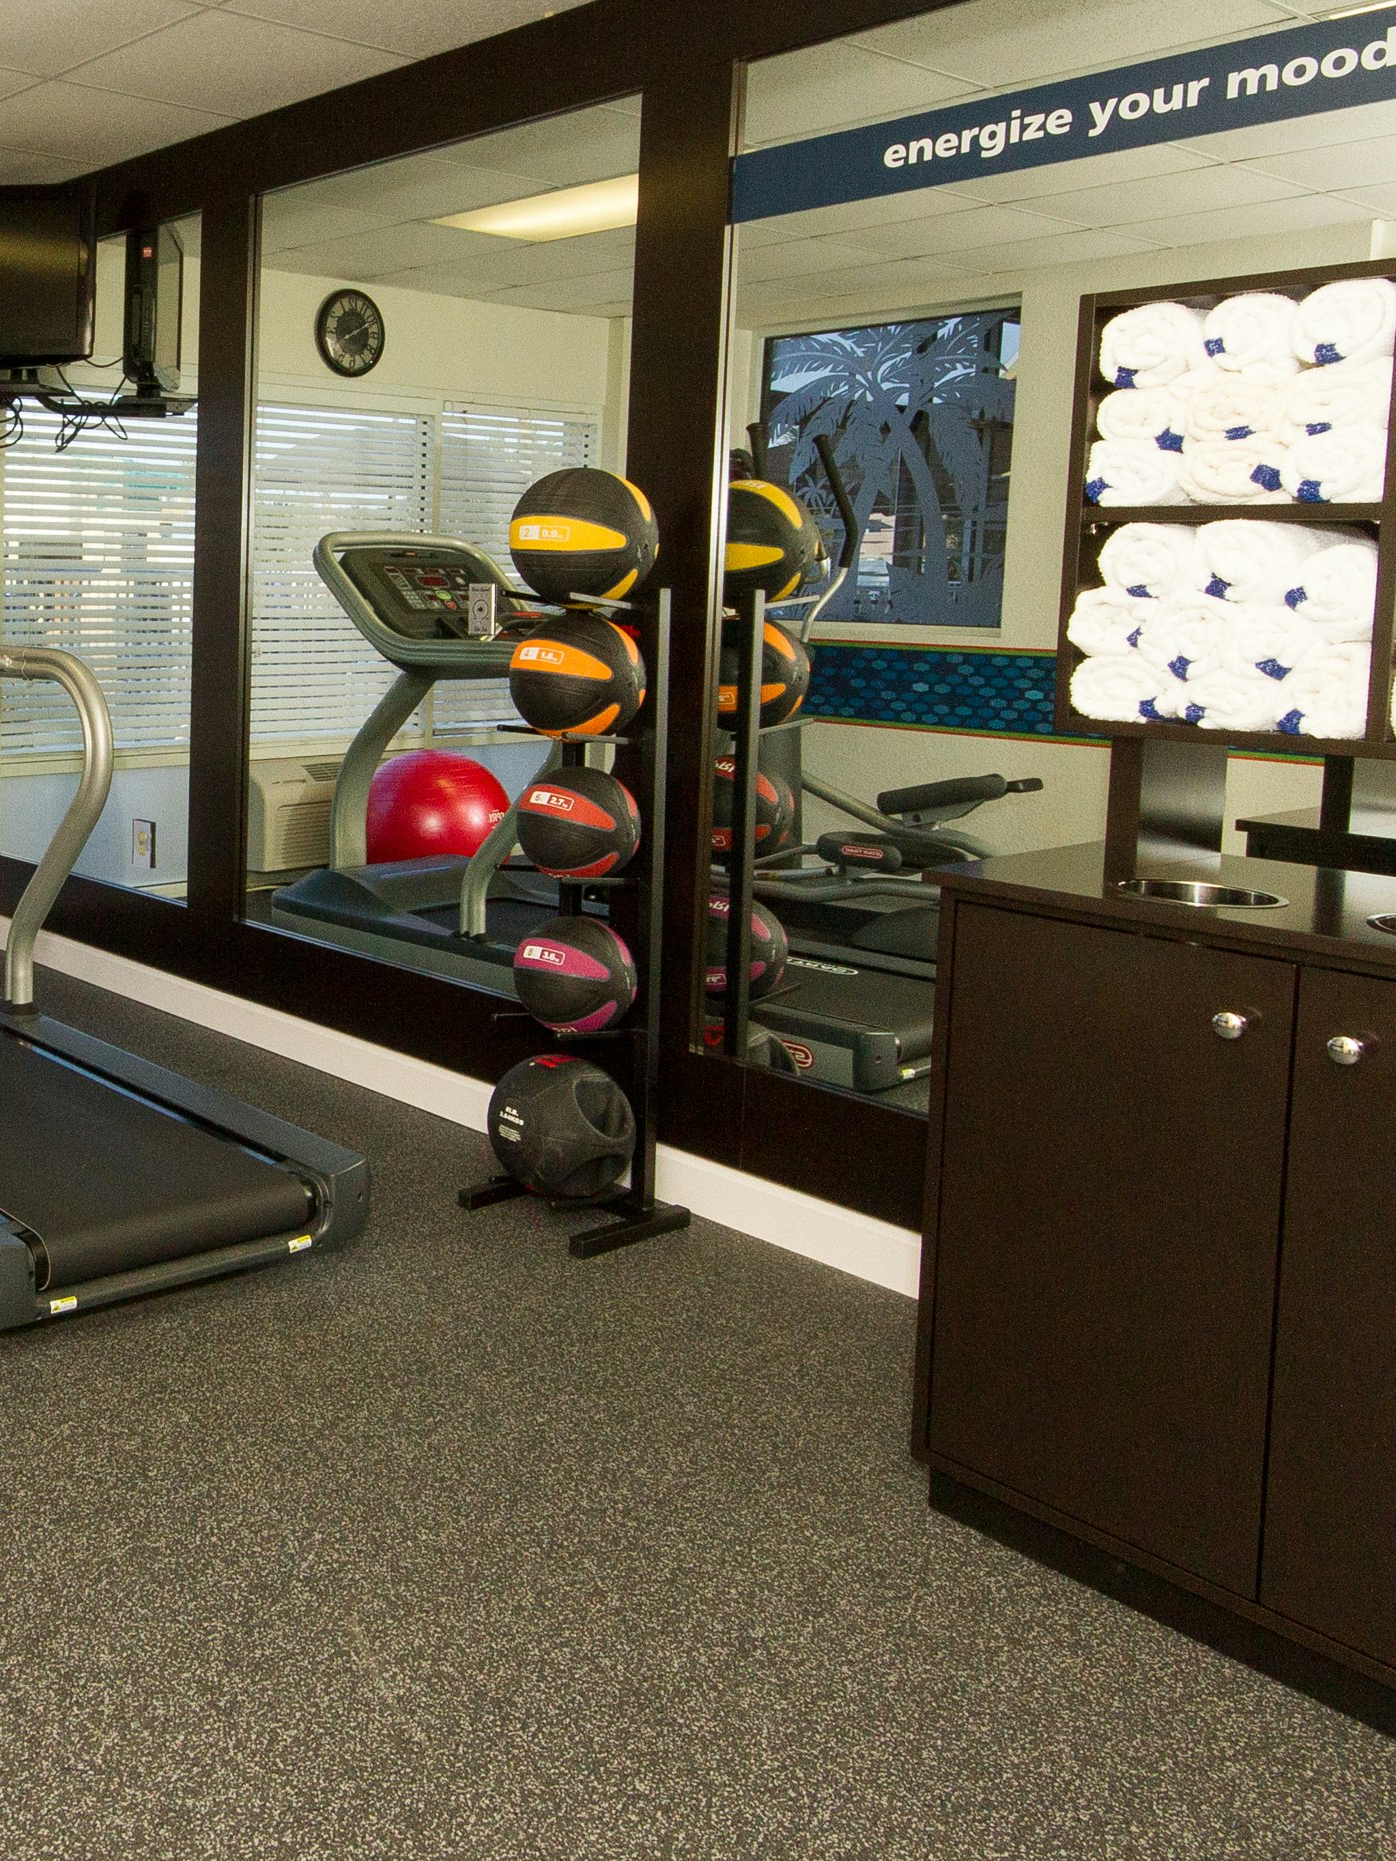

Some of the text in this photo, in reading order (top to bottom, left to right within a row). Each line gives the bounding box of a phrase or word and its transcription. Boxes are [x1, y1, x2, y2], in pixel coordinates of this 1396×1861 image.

[883, 26, 1396, 168] energize your mood
